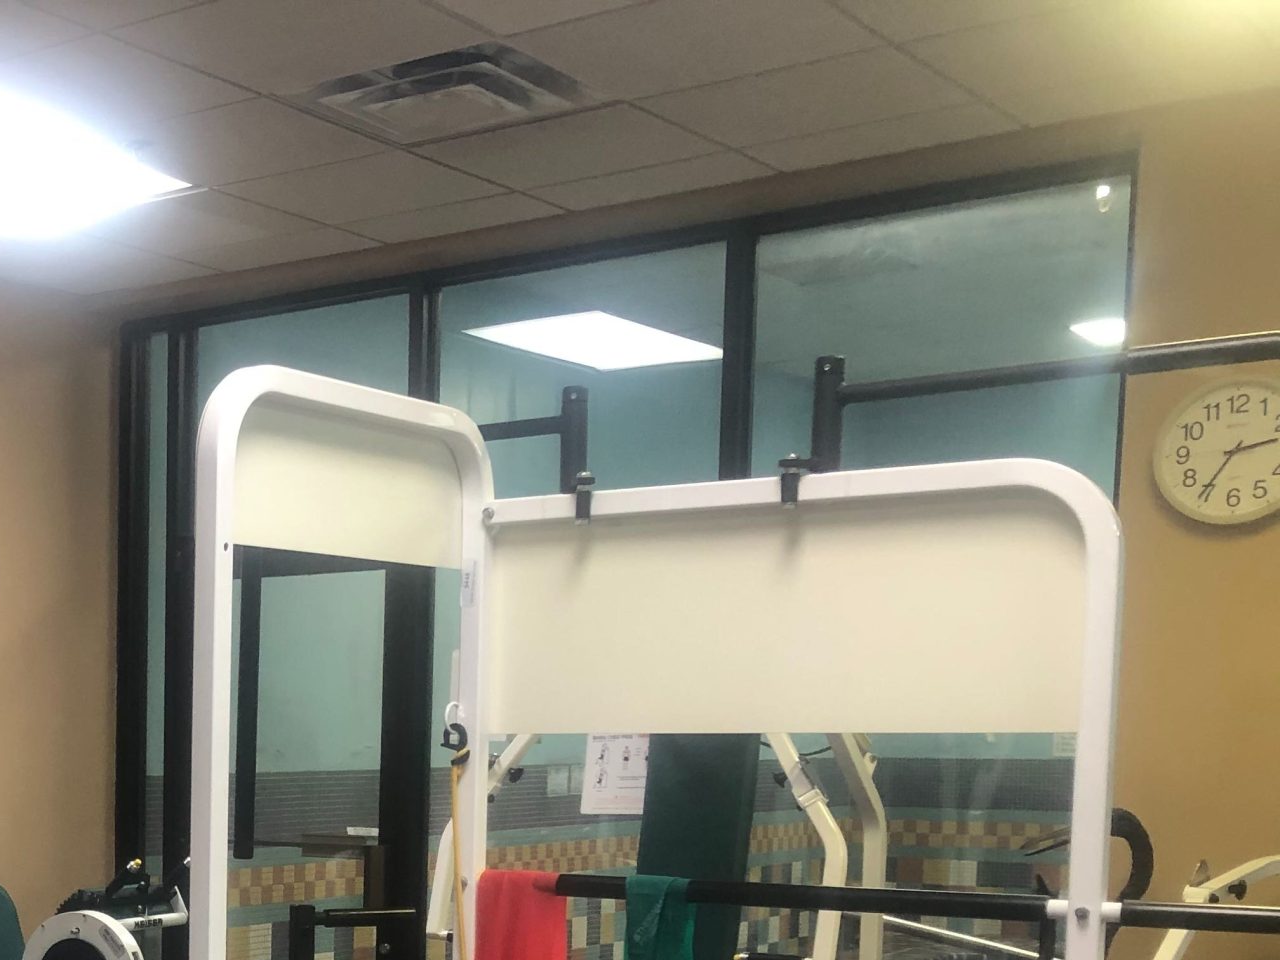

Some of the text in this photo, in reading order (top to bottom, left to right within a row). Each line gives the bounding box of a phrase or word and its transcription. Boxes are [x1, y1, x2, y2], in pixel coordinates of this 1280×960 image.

[1203, 402, 1220, 421] 11
[1227, 394, 1250, 414] 12
[1260, 397, 1268, 416] 1
[1181, 421, 1204, 441] 10
[1176, 446, 1190, 465] 9
[1182, 469, 1197, 488] 8
[1226, 488, 1241, 507] 6
[1252, 480, 1267, 499] 5
[134, 918, 163, 929] KEISER
